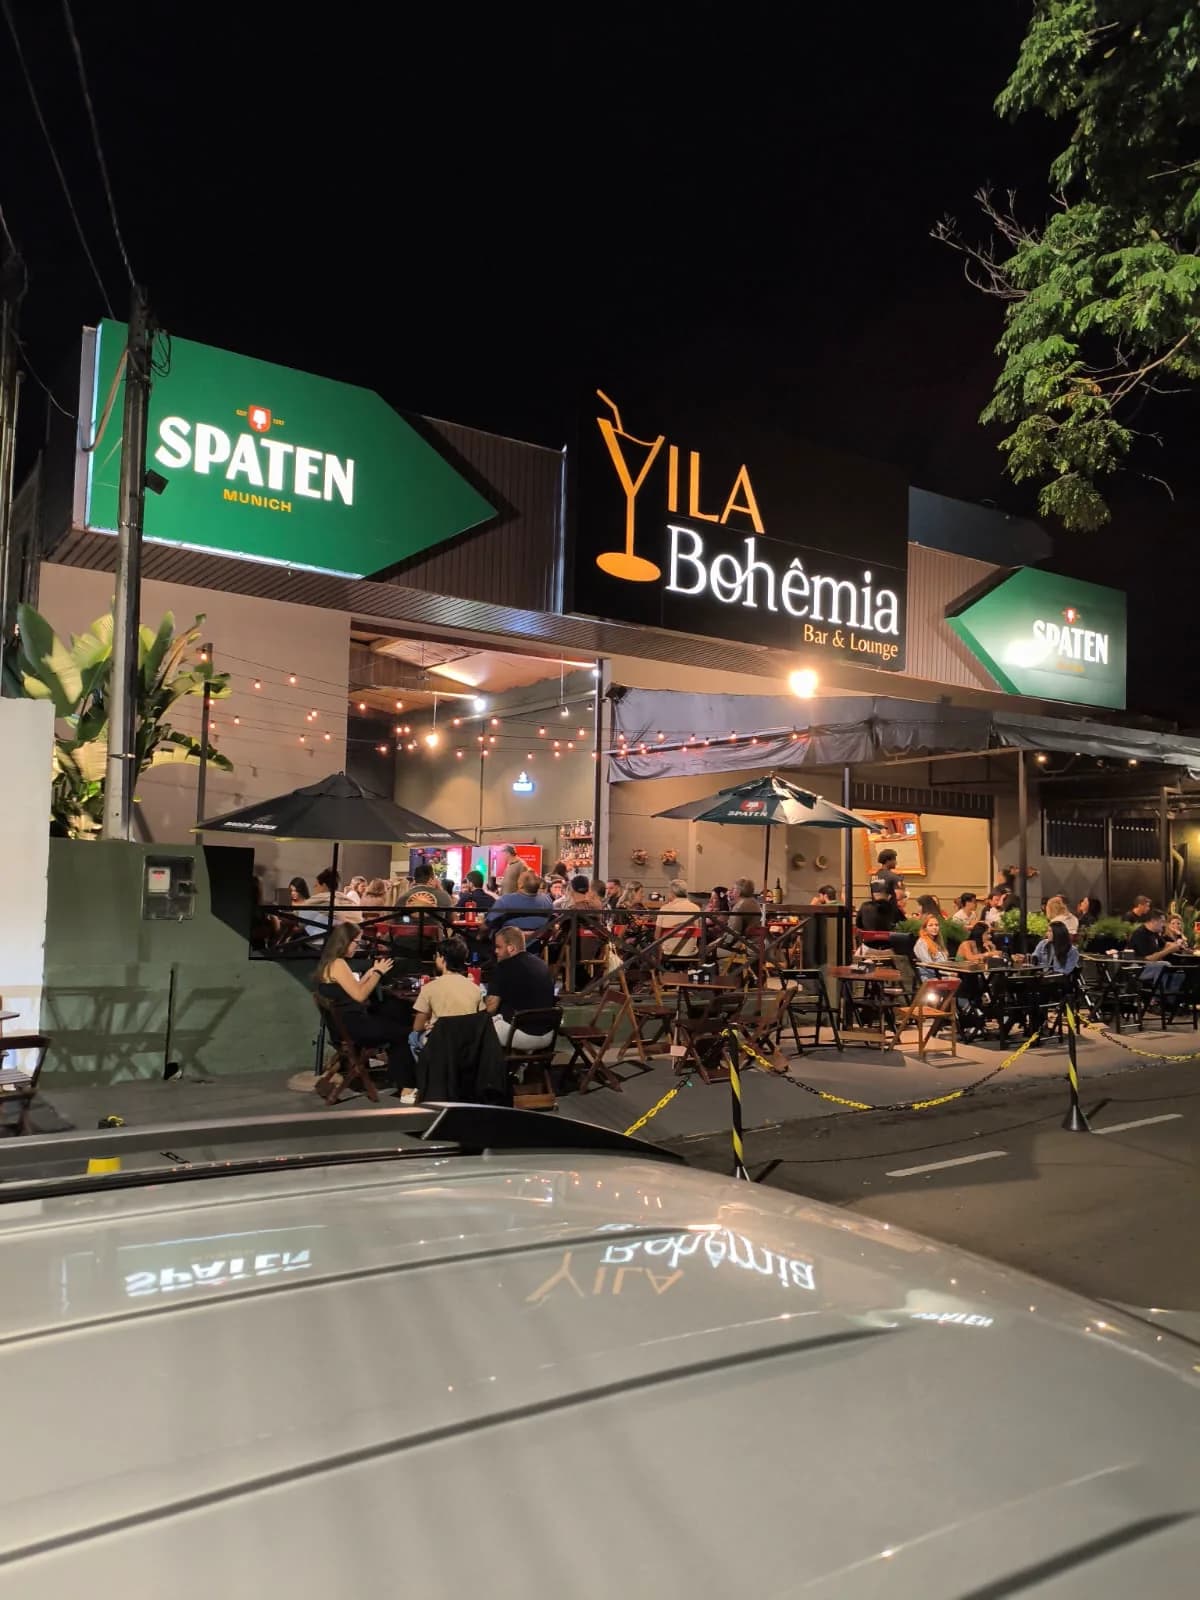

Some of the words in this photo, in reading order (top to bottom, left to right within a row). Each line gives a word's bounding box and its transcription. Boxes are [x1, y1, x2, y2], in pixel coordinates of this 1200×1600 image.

[154, 416, 355, 506] SPATEN
[223, 488, 293, 514] MUNICH
[665, 524, 899, 636] Bohêmia
[804, 623, 827, 646] Bar
[832, 630, 845, 649] &
[850, 634, 899, 661] Lounge
[1032, 619, 1109, 665] SPATEN
